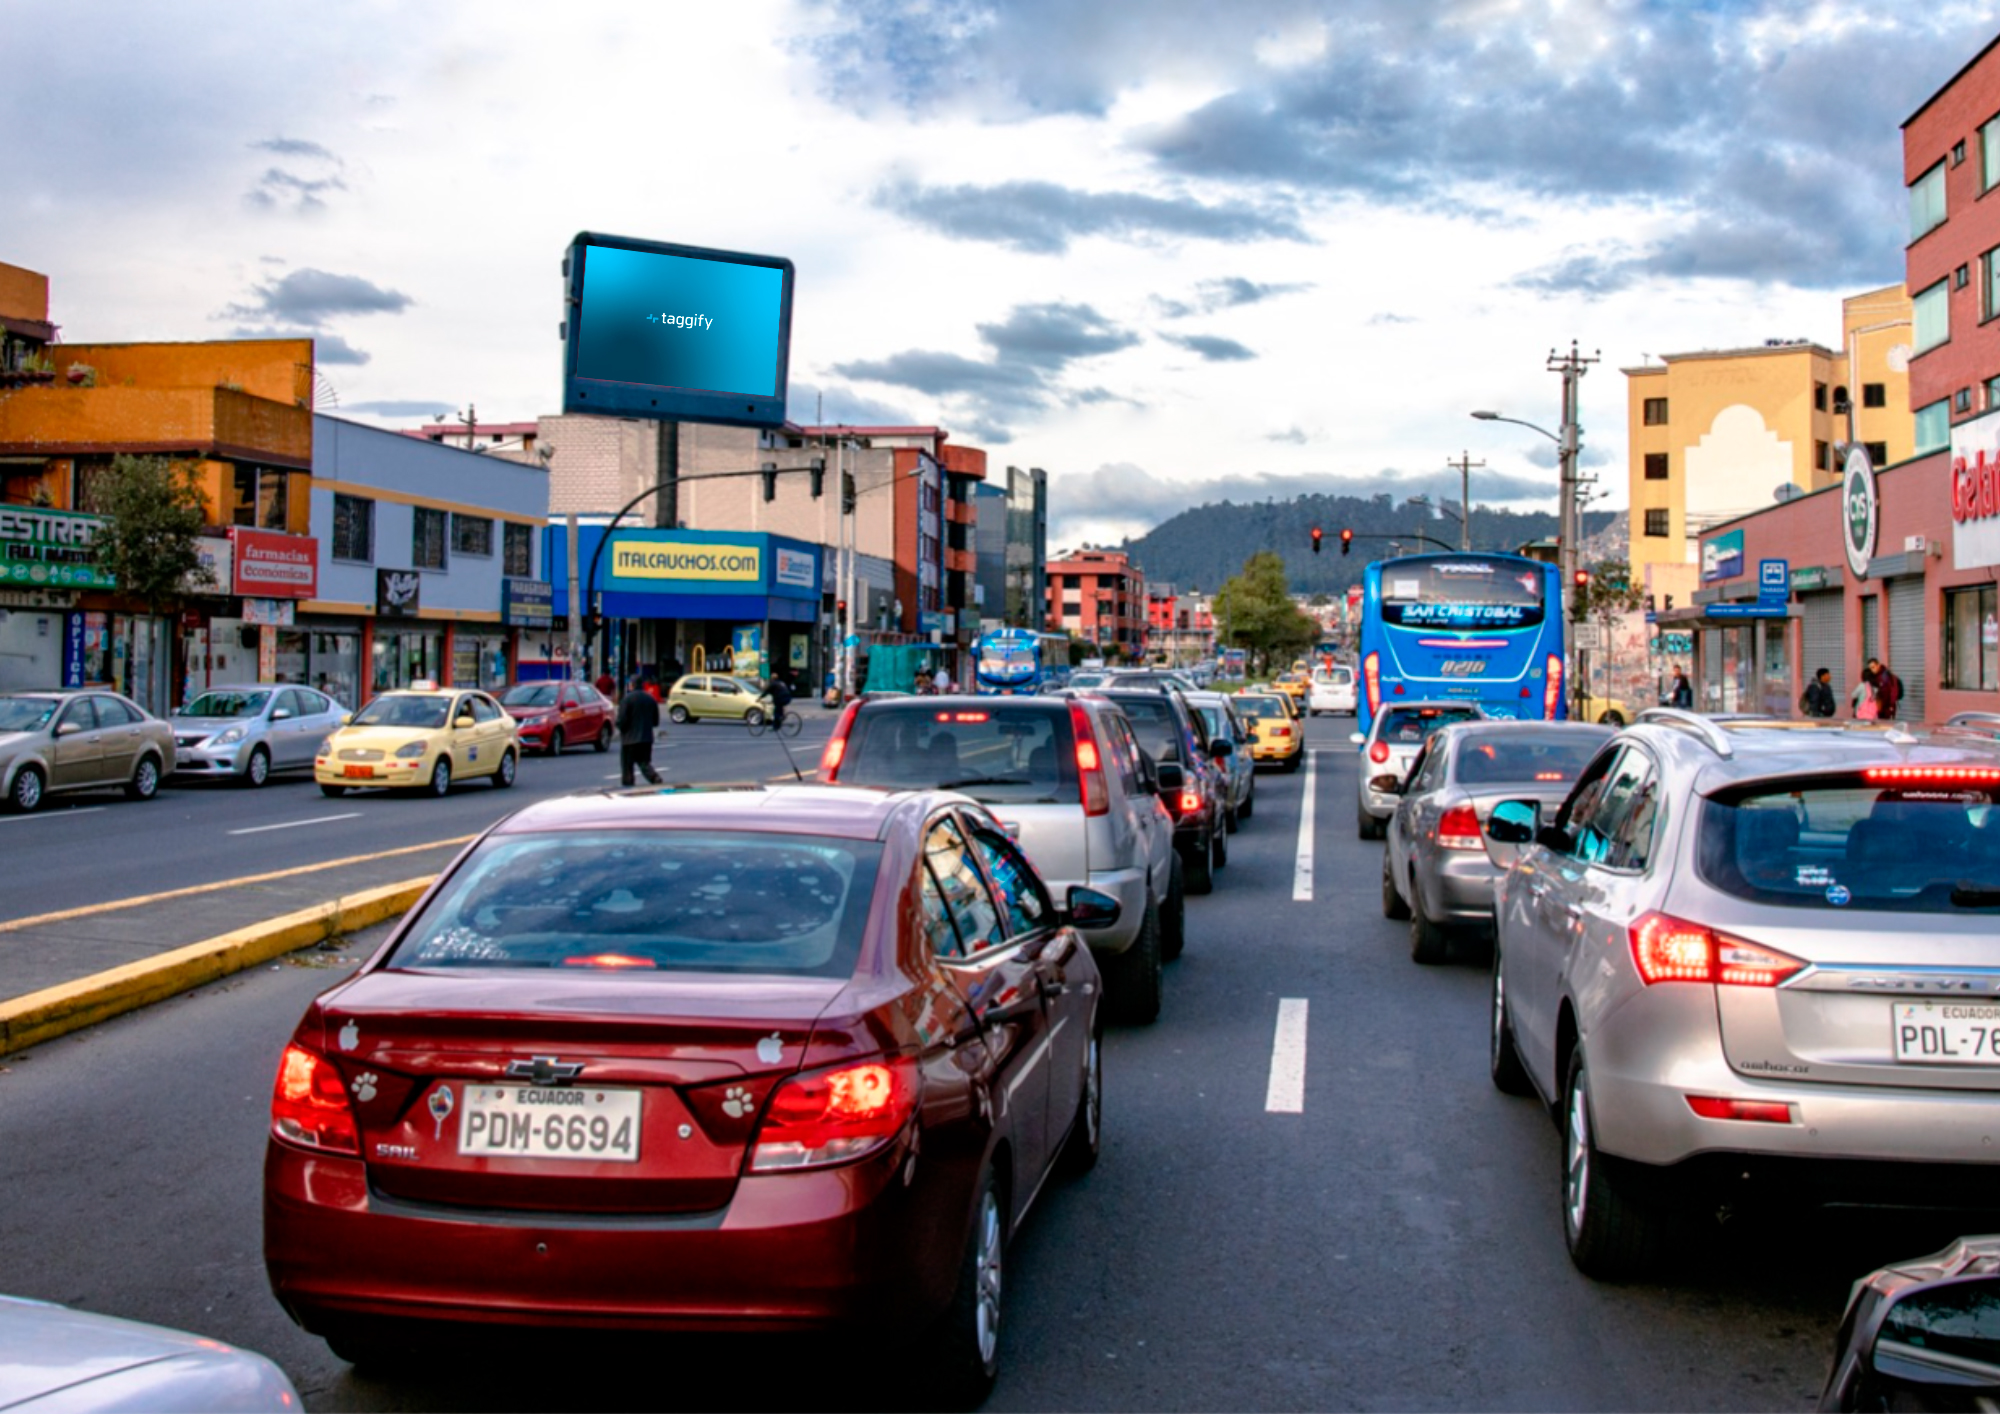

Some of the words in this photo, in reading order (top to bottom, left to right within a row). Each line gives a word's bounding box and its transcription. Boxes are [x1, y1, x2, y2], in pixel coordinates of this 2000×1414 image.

[661, 312, 714, 331] taggify
[245, 544, 310, 563] farmacias
[244, 564, 310, 580] económicas
[1402, 605, 1434, 617] SAN
[517, 1089, 585, 1106] ECUADOR
[465, 1110, 632, 1154] PDM-6694
[376, 1143, 420, 1160] SAIL
